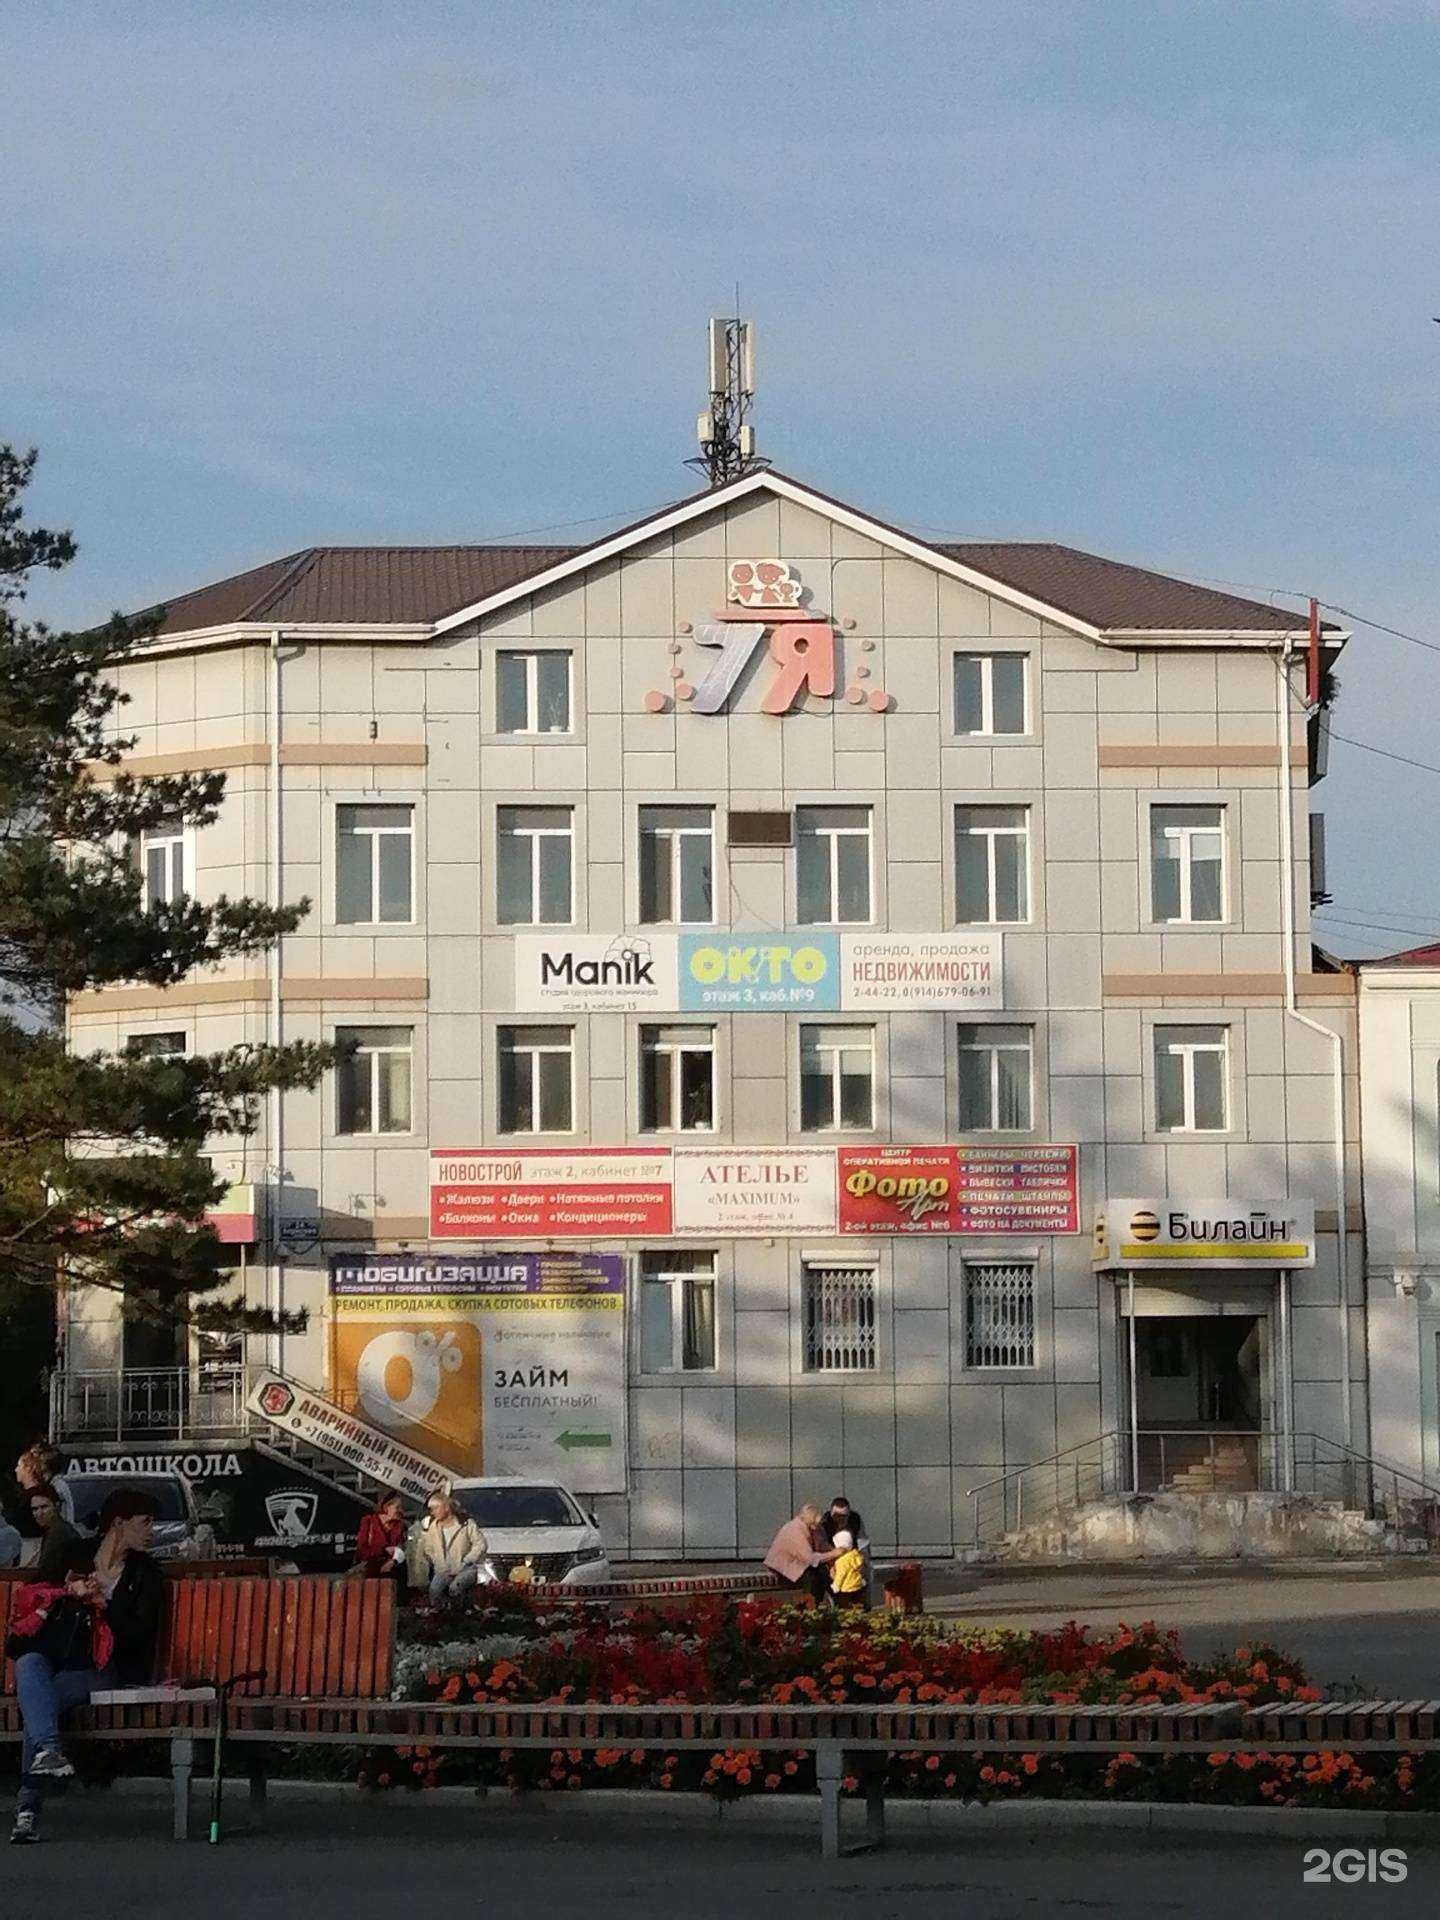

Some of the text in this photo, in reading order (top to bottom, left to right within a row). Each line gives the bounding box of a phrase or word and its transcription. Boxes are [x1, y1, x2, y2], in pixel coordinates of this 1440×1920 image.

[853, 944, 989, 959] аренда, продажа
[540, 949, 655, 985] Manik
[853, 962, 991, 982] НЕДВИЖИМОСТИ
[702, 991, 740, 1002] этаж
[743, 988, 757, 1003] 3,
[439, 1161, 522, 1181] НОВОСТРОЙ
[529, 1168, 562, 1178] этаж
[565, 1165, 577, 1179] 2,
[581, 1165, 637, 1178] кабинет
[700, 1165, 808, 1184] АТЕЛЬЕ
[846, 1169, 949, 1197] Фото
[508, 1194, 544, 1207] Двери
[708, 1192, 800, 1205] «MAXIMUM»
[508, 1214, 540, 1224] Окна
[556, 1211, 648, 1224] Кондиционеры
[970, 1206, 1067, 1215] ФОТОСУВЕНИРЫ
[1011, 1220, 1067, 1229] ДОКУМЕНТЫ
[1169, 1212, 1287, 1240] Билайн
[448, 1299, 491, 1310] СКУПКА
[495, 1299, 547, 1309] СОТОВЫХ
[550, 1298, 617, 1309] ТЕЛЕФОНОВ
[495, 1366, 568, 1387] ЗАЙМ
[495, 1395, 598, 1408] БЕСПЛАТНЫЙ!
[67, 1454, 242, 1476] АВТОШКОЛА
